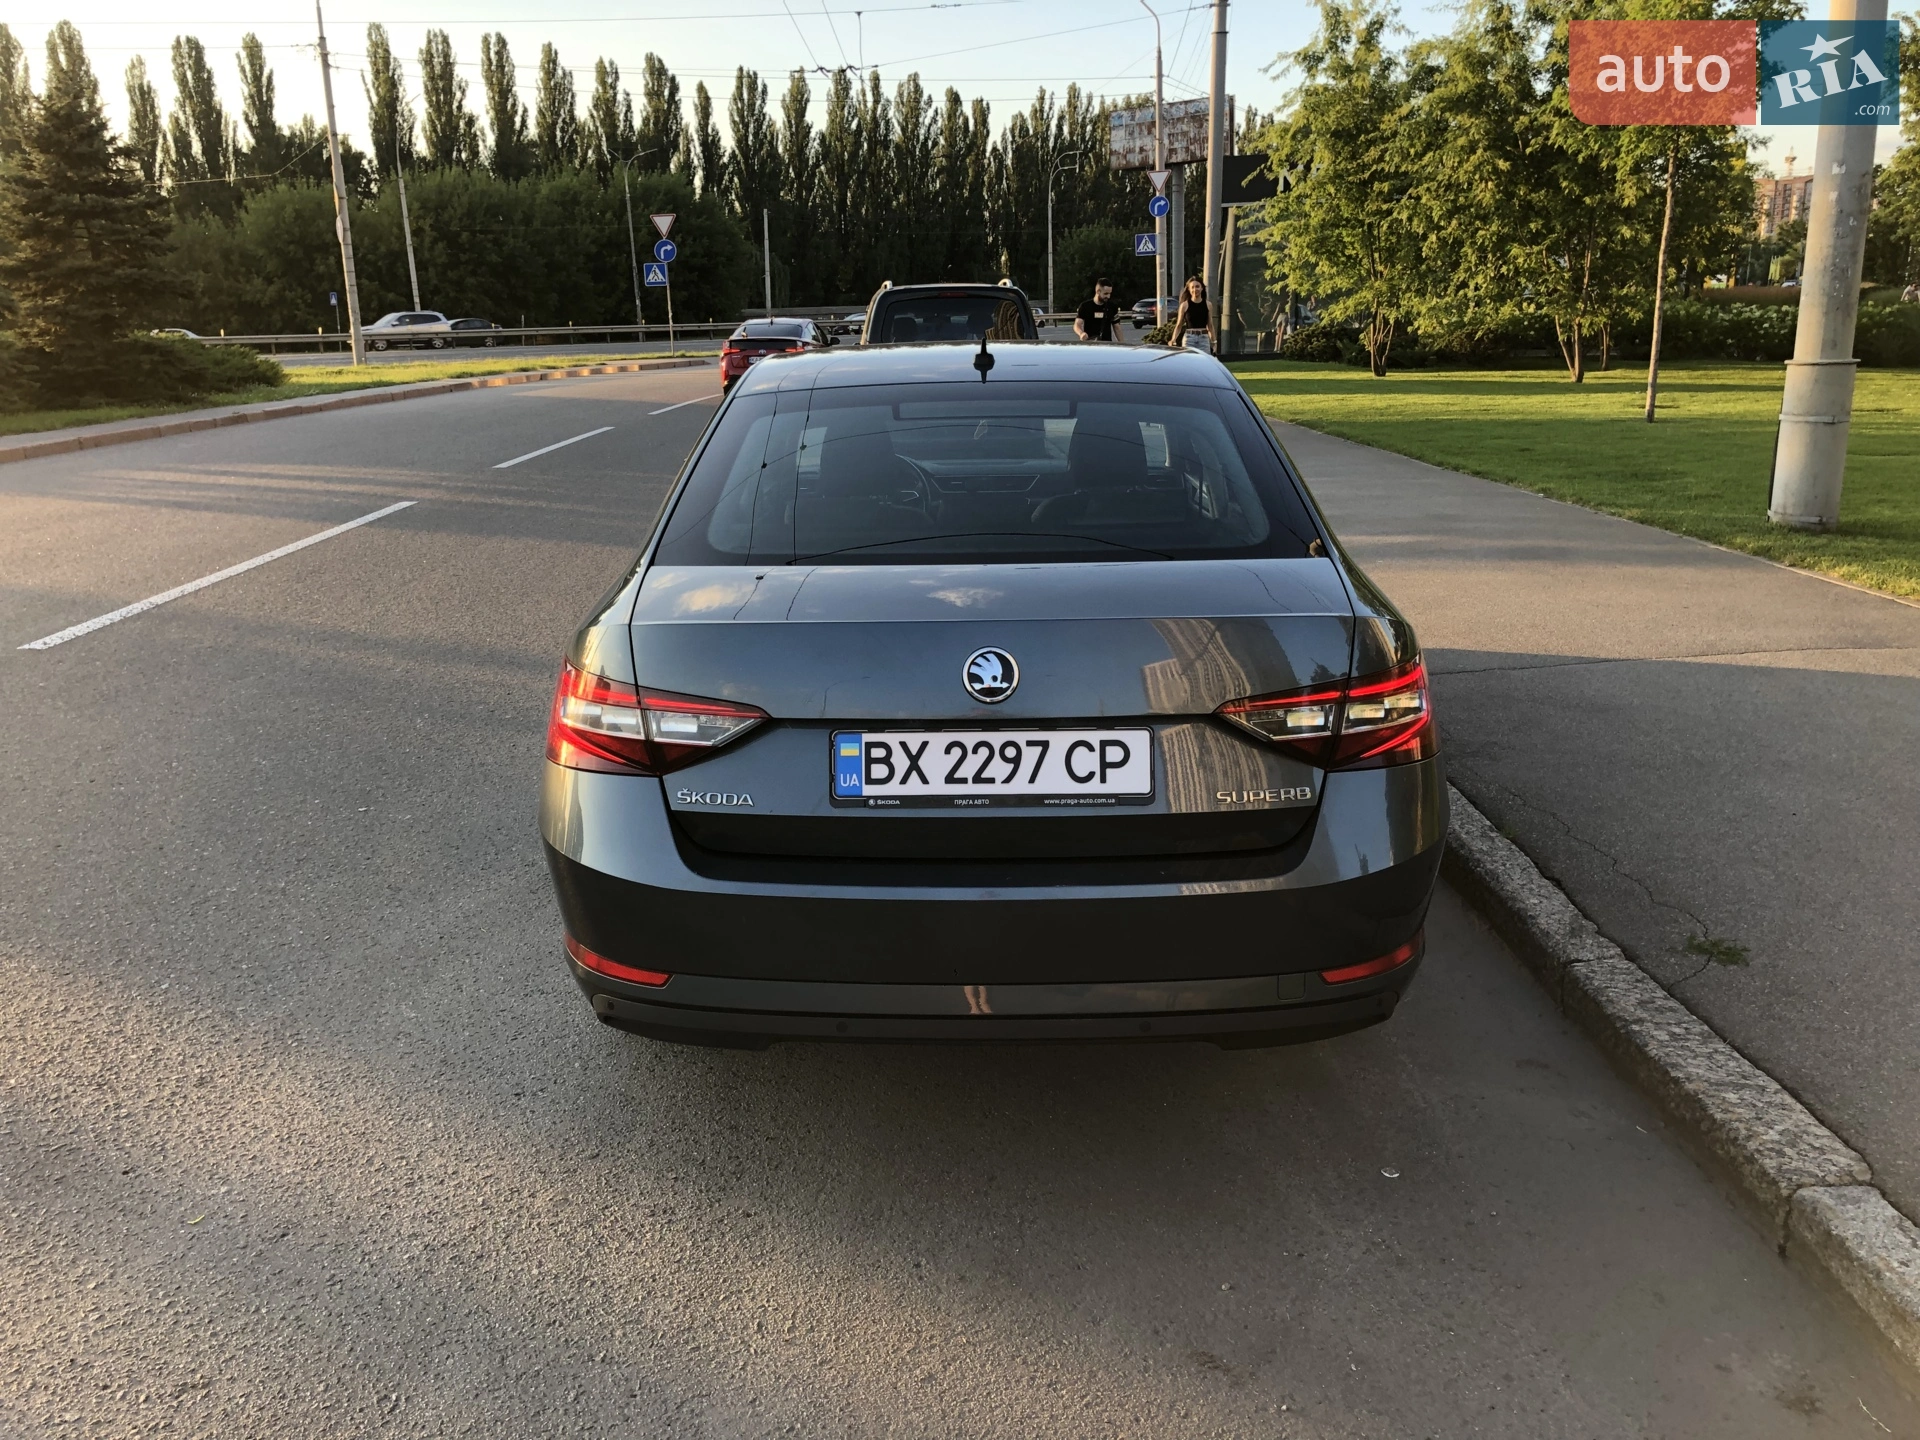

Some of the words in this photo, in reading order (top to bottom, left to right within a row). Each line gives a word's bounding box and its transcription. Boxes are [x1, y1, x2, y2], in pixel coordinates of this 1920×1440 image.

[864, 741, 930, 786] BX
[944, 740, 1050, 785] 2297
[1064, 739, 1131, 784] CP
[840, 773, 860, 788] UA
[676, 788, 755, 807] ŠKODA
[1216, 786, 1312, 804] SUPERB
